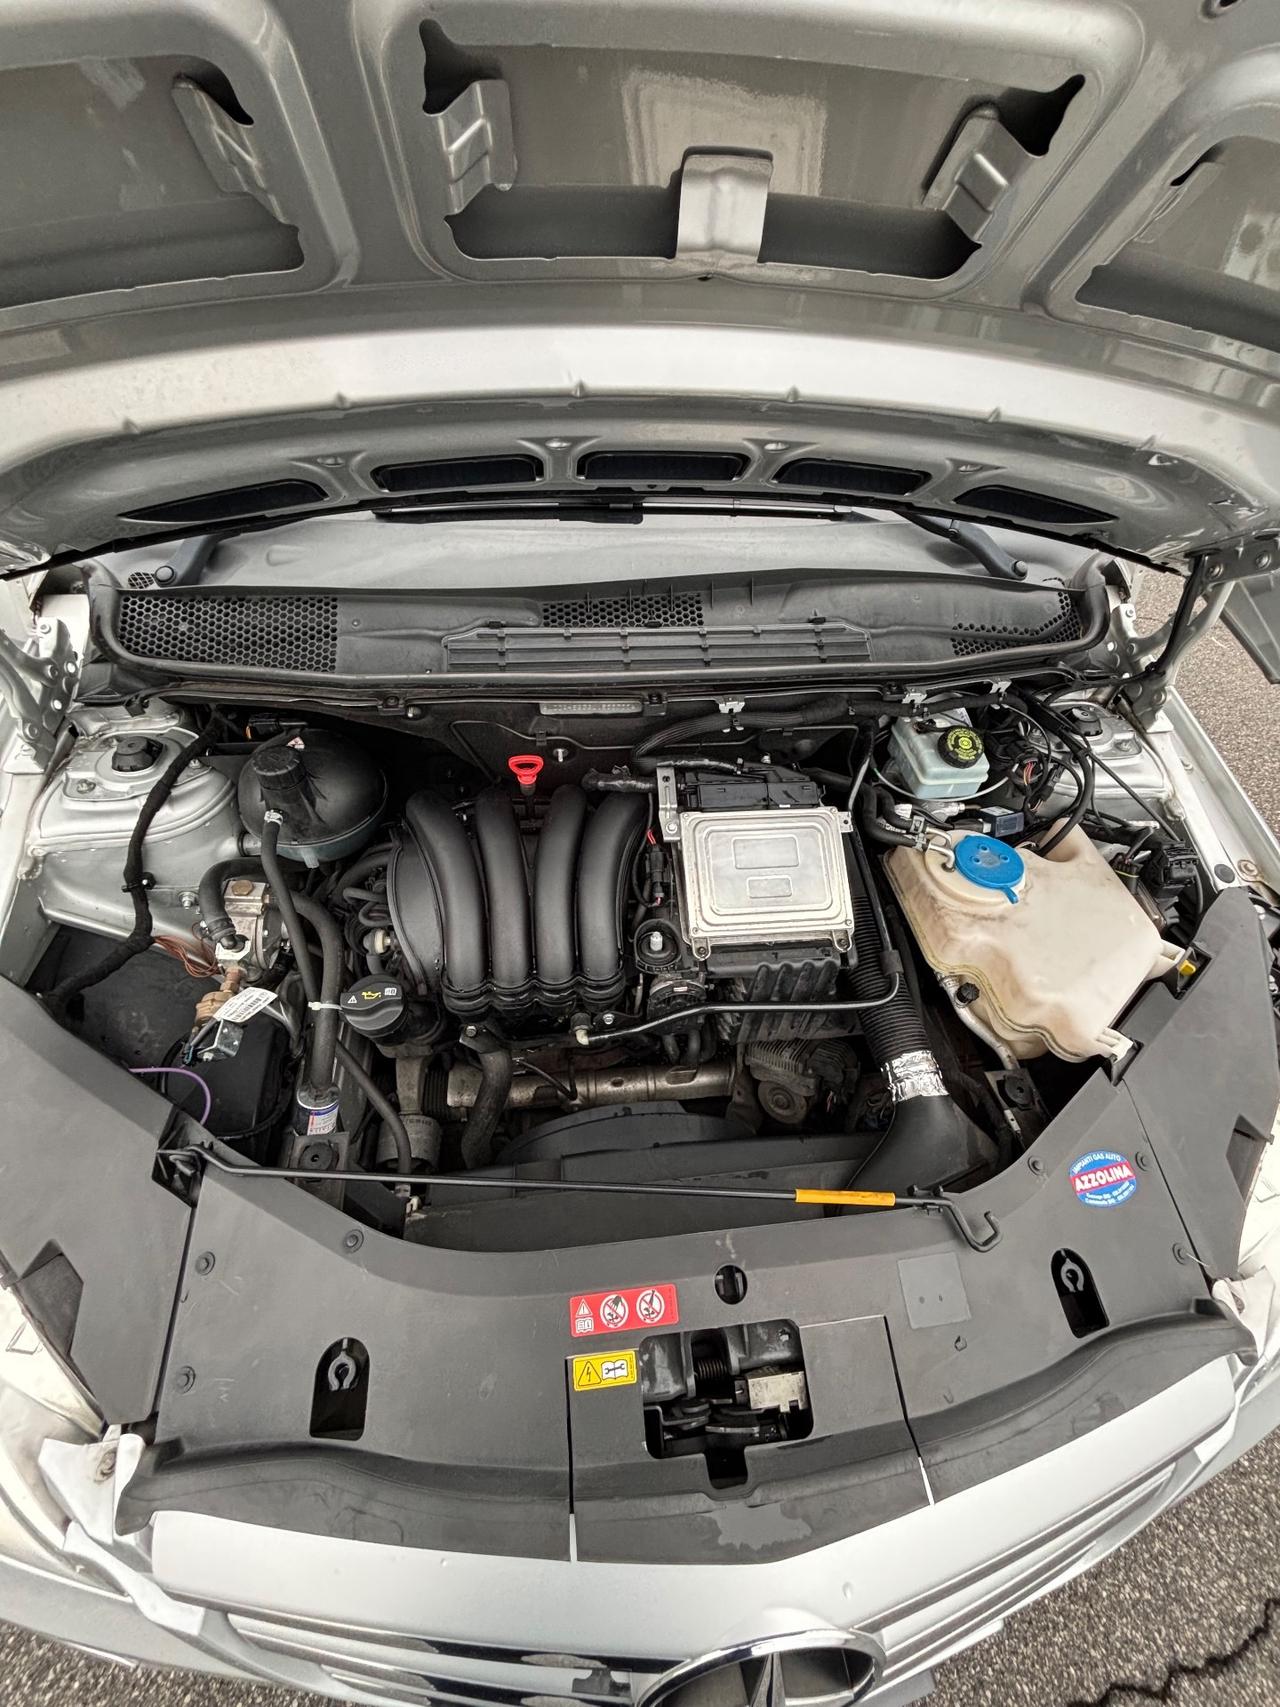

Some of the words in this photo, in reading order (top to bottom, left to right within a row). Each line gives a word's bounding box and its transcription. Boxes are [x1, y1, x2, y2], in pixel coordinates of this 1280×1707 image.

[1072, 1156, 1093, 1174] IMPIANTI
[1093, 1153, 1105, 1161] GAS
[1105, 1153, 1121, 1162] AUTO
[1075, 1164, 1133, 1192] AZZOLINA
